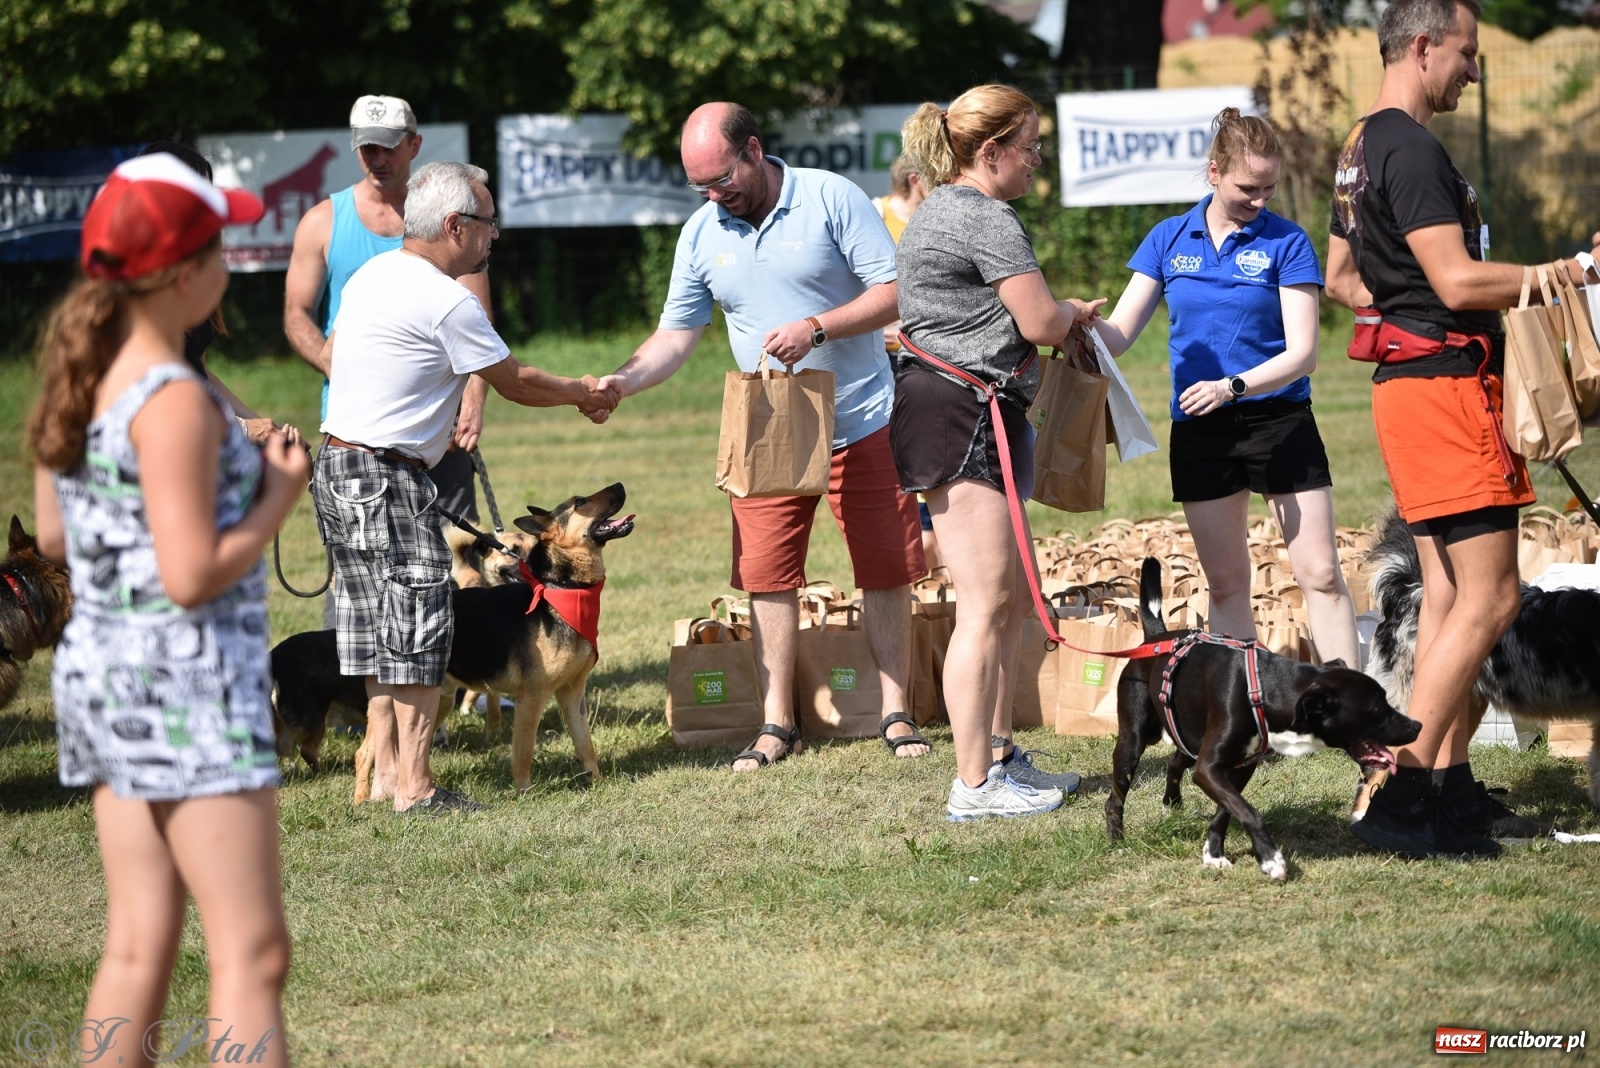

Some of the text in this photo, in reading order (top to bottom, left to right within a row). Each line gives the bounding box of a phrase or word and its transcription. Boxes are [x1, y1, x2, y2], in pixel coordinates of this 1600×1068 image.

[1079, 127, 1180, 171] HAPPY
[516, 149, 620, 196] HAPPY
[1182, 255, 1202, 264] ZOO
[706, 681, 722, 689] ZOO
